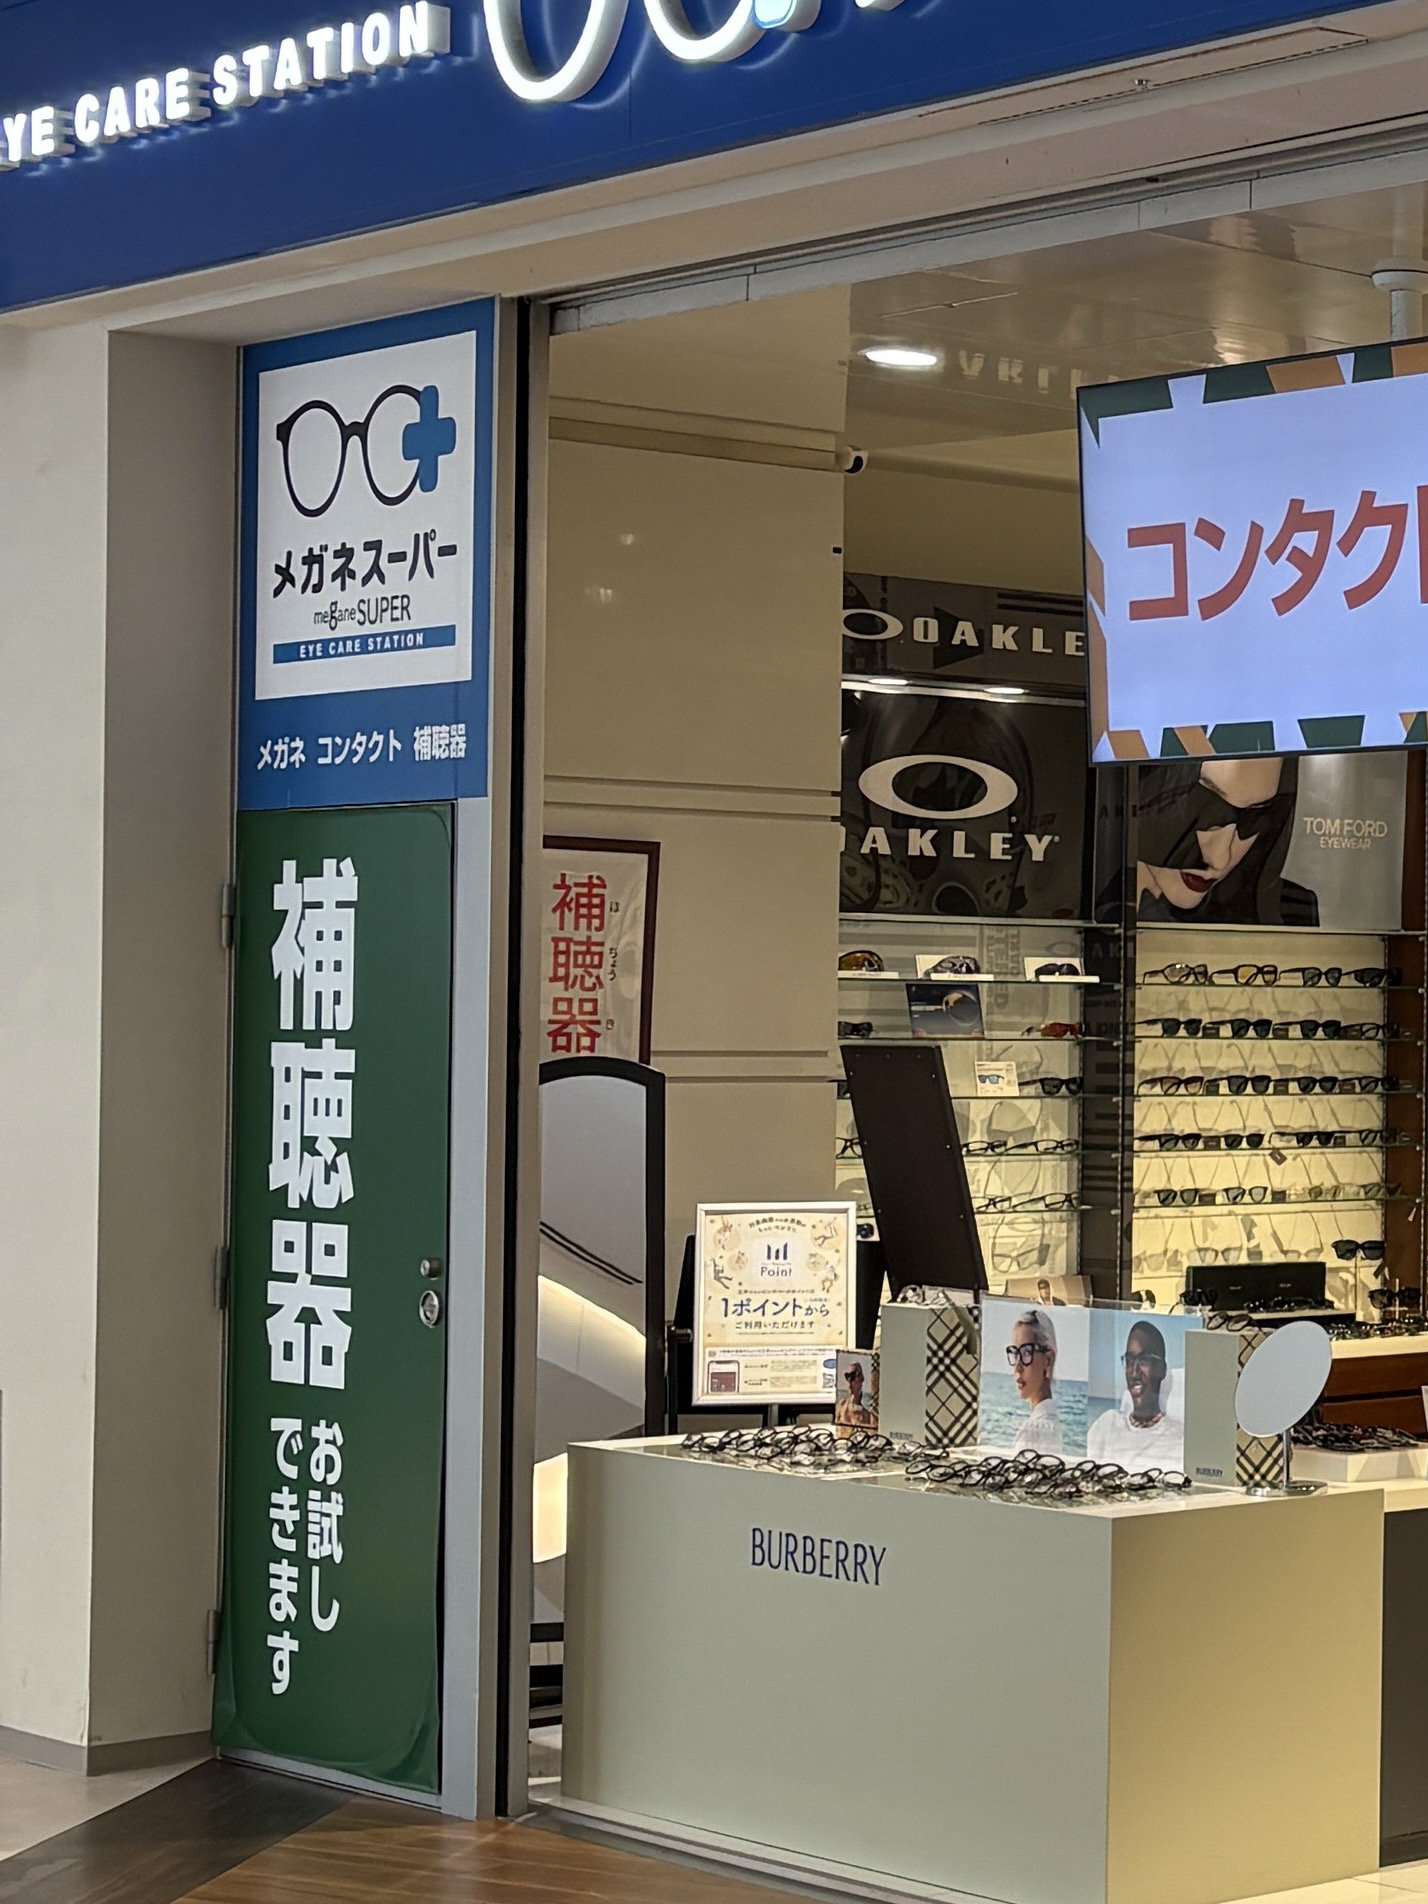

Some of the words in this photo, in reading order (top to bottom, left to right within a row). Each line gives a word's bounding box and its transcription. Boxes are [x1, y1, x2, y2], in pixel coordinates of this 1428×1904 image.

[74, 69, 192, 143] CARE
[213, 1, 446, 106] STATION
[272, 528, 458, 598] メガネスーパー
[299, 642, 323, 658] EYE
[328, 638, 362, 655] CARE
[367, 632, 425, 650] STATION
[912, 616, 1086, 656] OAKLE
[257, 736, 306, 770] メガネ
[318, 729, 402, 765] コンタクト
[413, 724, 467, 761] 補聴器
[841, 826, 1053, 862] AKLEY
[1303, 818, 1339, 837] TOM
[1341, 820, 1388, 839] FORD
[1319, 836, 1372, 851] EYEWEAR
[546, 873, 608, 1054] 補聴器
[266, 858, 359, 1392] 補聴器
[760, 1265, 793, 1277] Point
[306, 1419, 344, 1634] お試し
[267, 1417, 307, 1696] できます
[750, 1526, 887, 1586] BURBERRY
